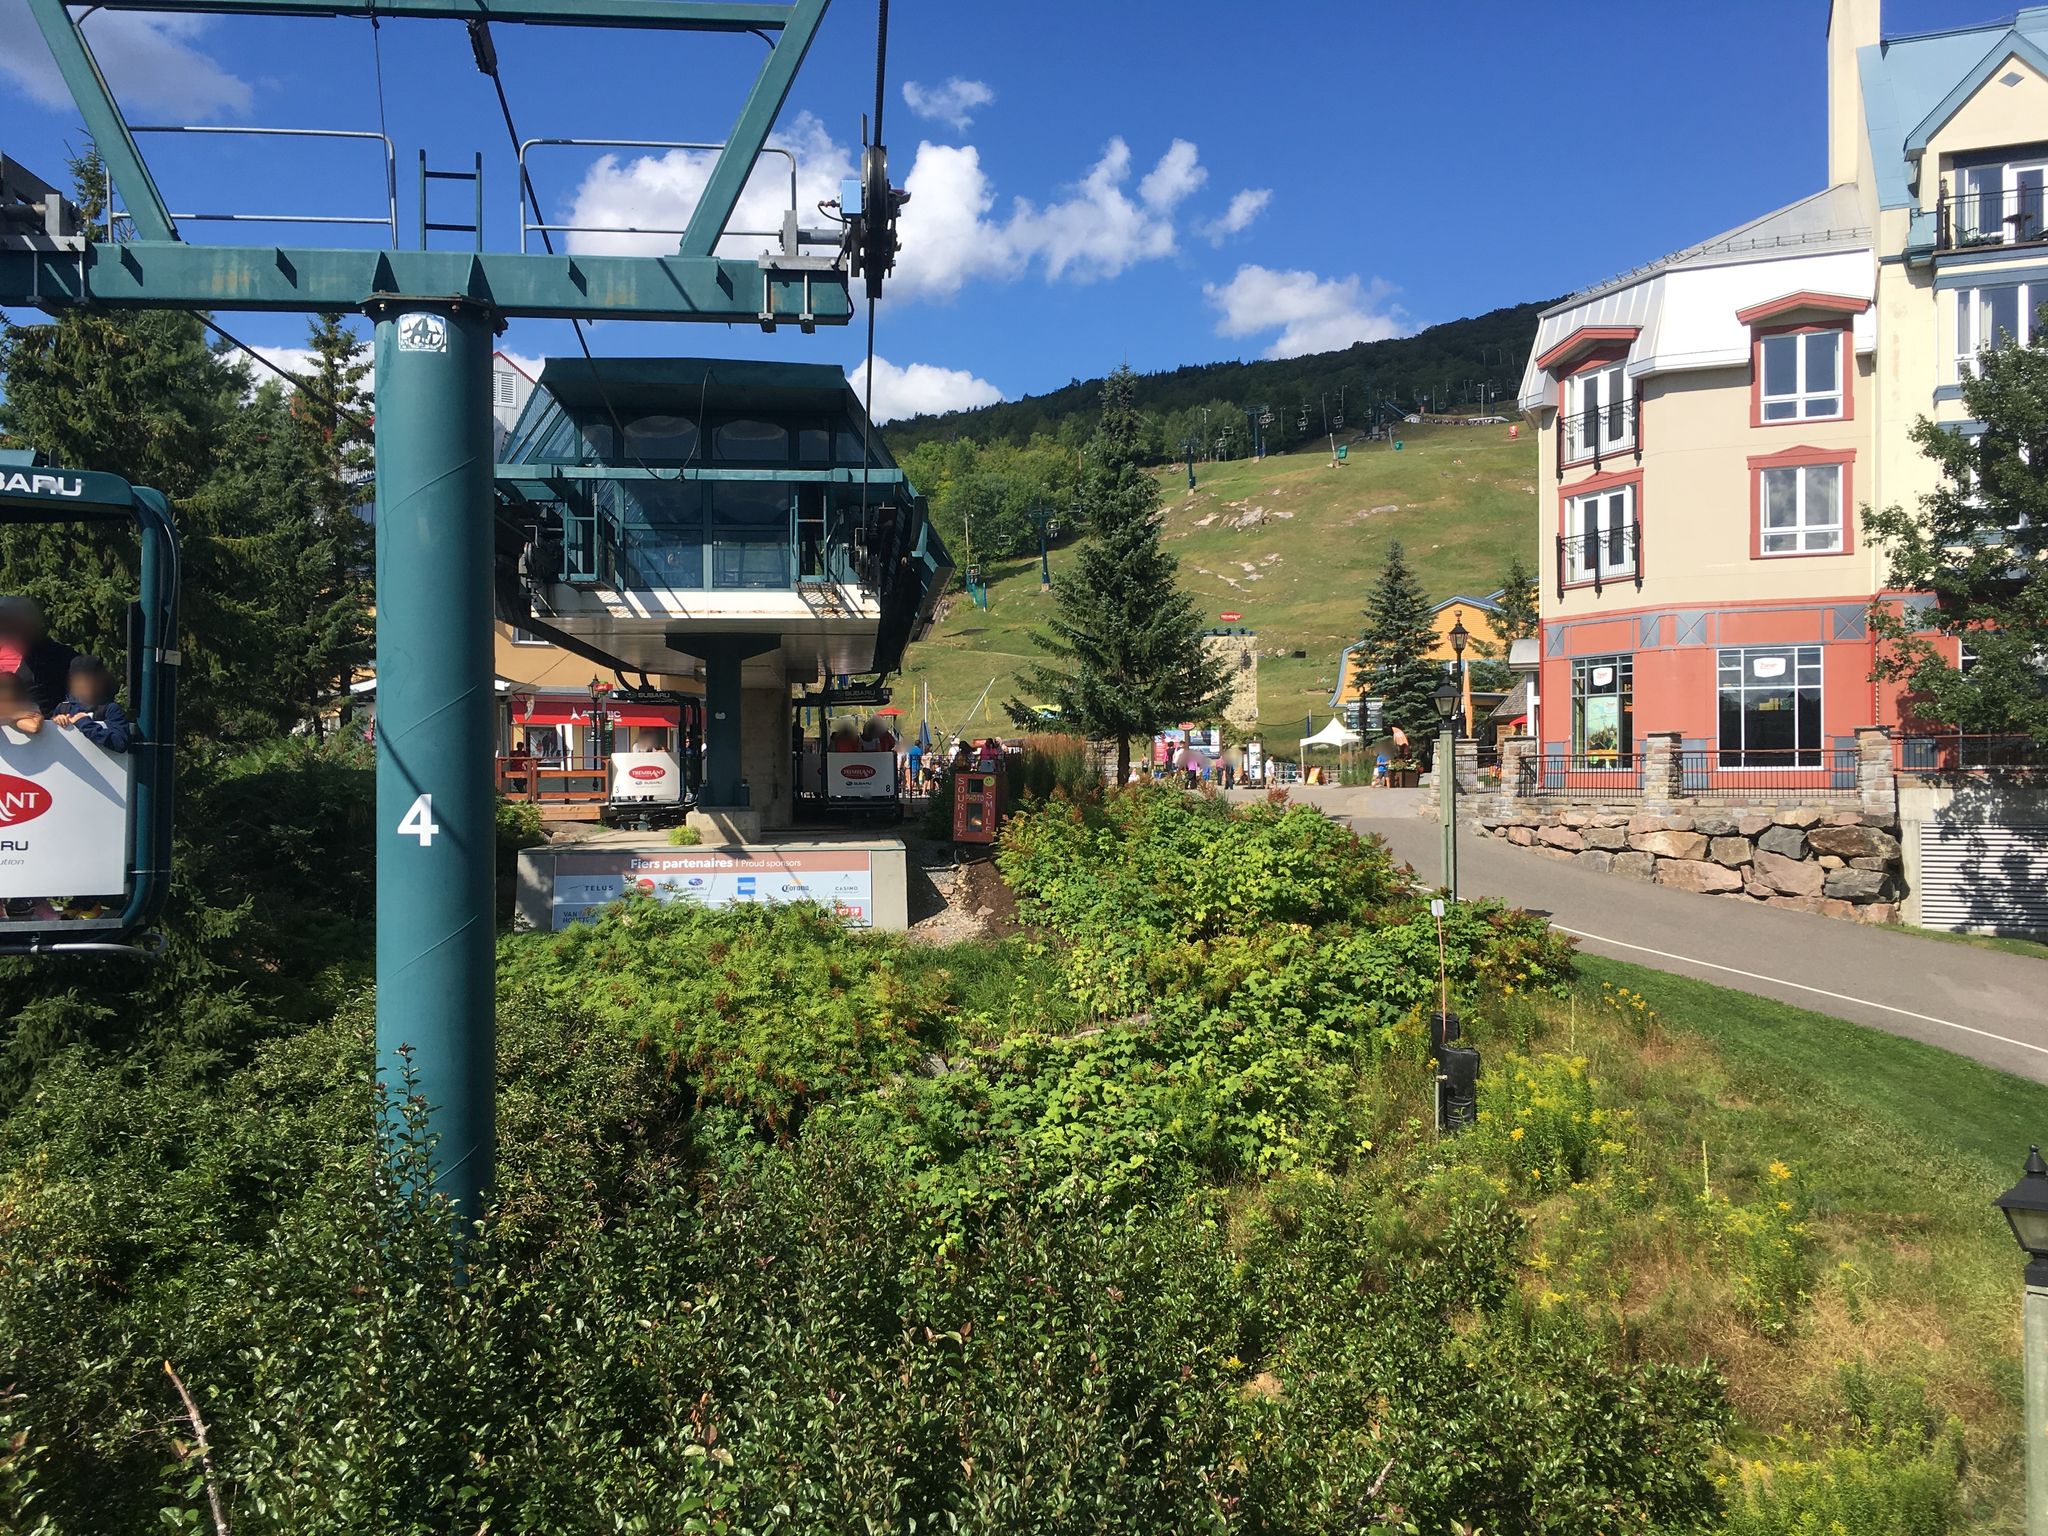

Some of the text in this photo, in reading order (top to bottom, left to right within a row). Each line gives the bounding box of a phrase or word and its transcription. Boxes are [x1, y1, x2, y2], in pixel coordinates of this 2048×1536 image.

[885, 784, 891, 792] 8
[957, 777, 965, 836] SOURIEZ
[397, 793, 439, 846] 4
[985, 791, 993, 834] SMILE
[631, 857, 802, 870] Fiers partenaires Proud sponsors
